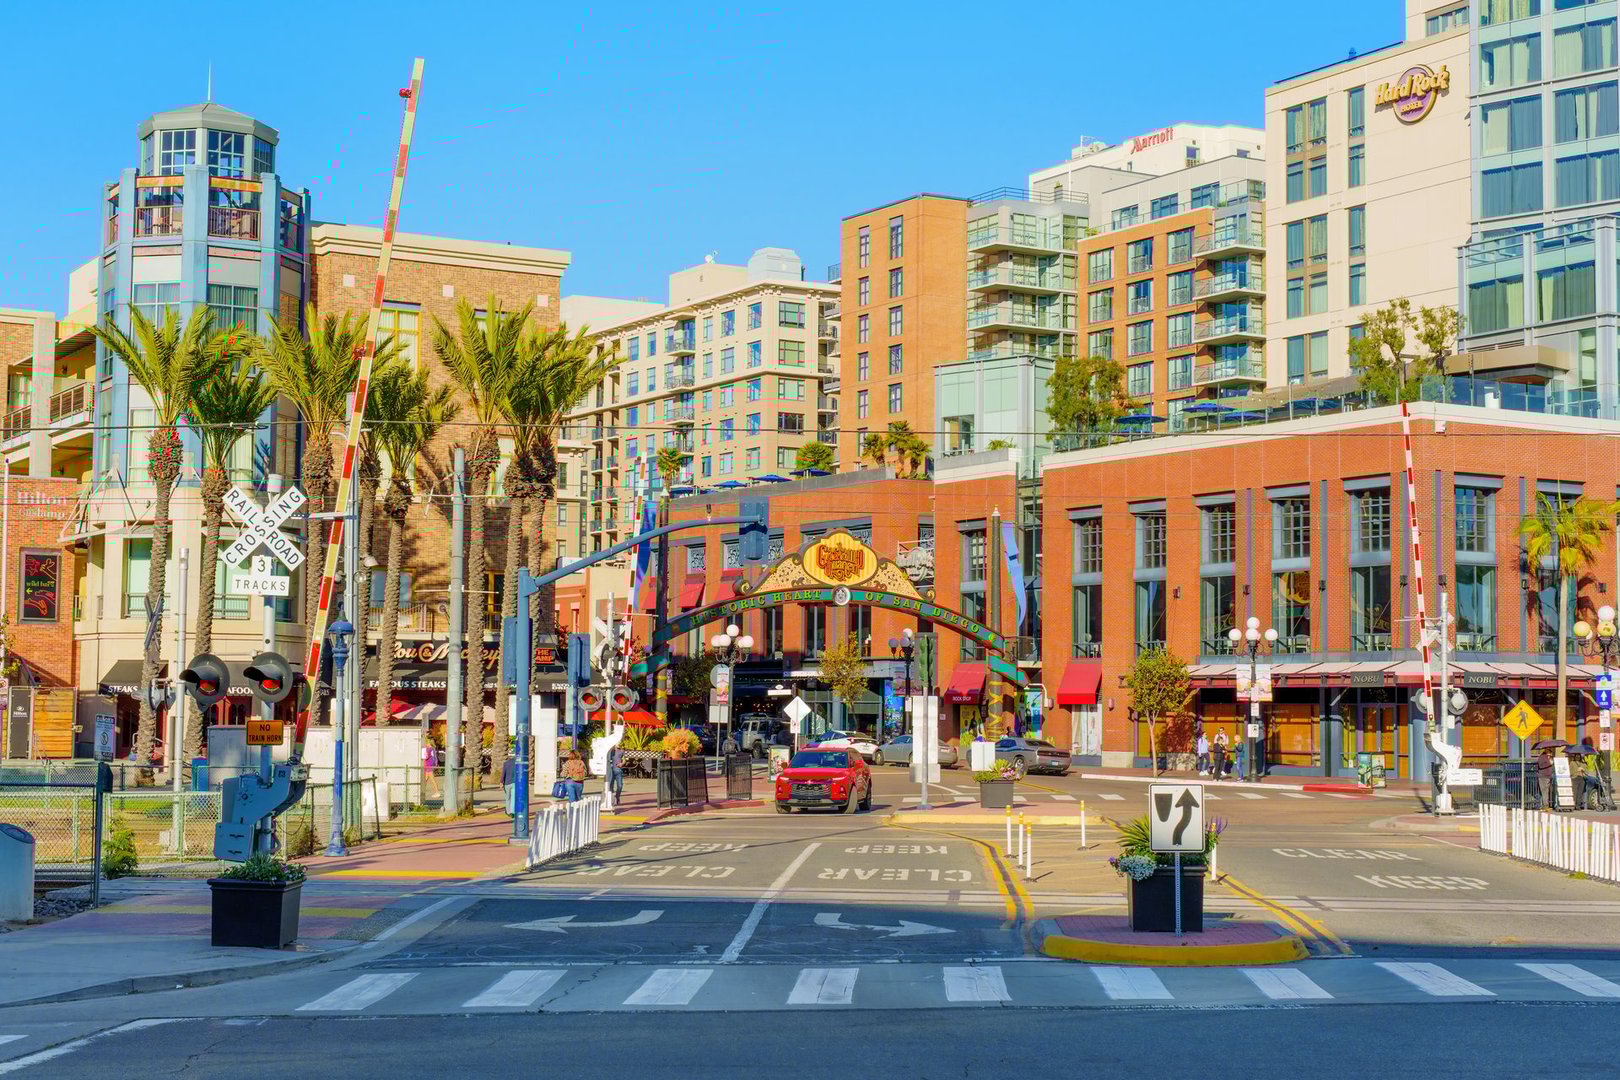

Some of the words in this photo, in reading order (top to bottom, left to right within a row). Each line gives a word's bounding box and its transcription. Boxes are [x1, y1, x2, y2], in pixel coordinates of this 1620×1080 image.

[1375, 75, 1414, 106] Hard
[1412, 65, 1450, 96] Rock
[1401, 101, 1423, 113] HOTEL
[1130, 127, 1173, 155] Marriott
[17, 491, 68, 504] Hilton
[225, 491, 301, 564] CROSSING
[257, 559, 266, 573] 3
[235, 579, 286, 591] TRACKS
[690, 594, 766, 625] HISTORIC
[772, 589, 822, 602] HEART
[865, 592, 884, 601] OF
[893, 597, 922, 609] SAN
[932, 608, 979, 633] DIEGO
[1353, 675, 1380, 683] NOBU
[1468, 675, 1496, 683] NOBU
[108, 685, 138, 693] STEAKS
[227, 687, 255, 695] AFOO
[259, 724, 271, 732] NO
[249, 734, 265, 743] TRAIN
[266, 734, 282, 743] HORN
[638, 843, 750, 853] KEEP
[845, 845, 948, 855] KEEP
[1271, 848, 1423, 861] CLEAR
[817, 867, 972, 882] CLEAR
[1353, 874, 1490, 890] KEEP
